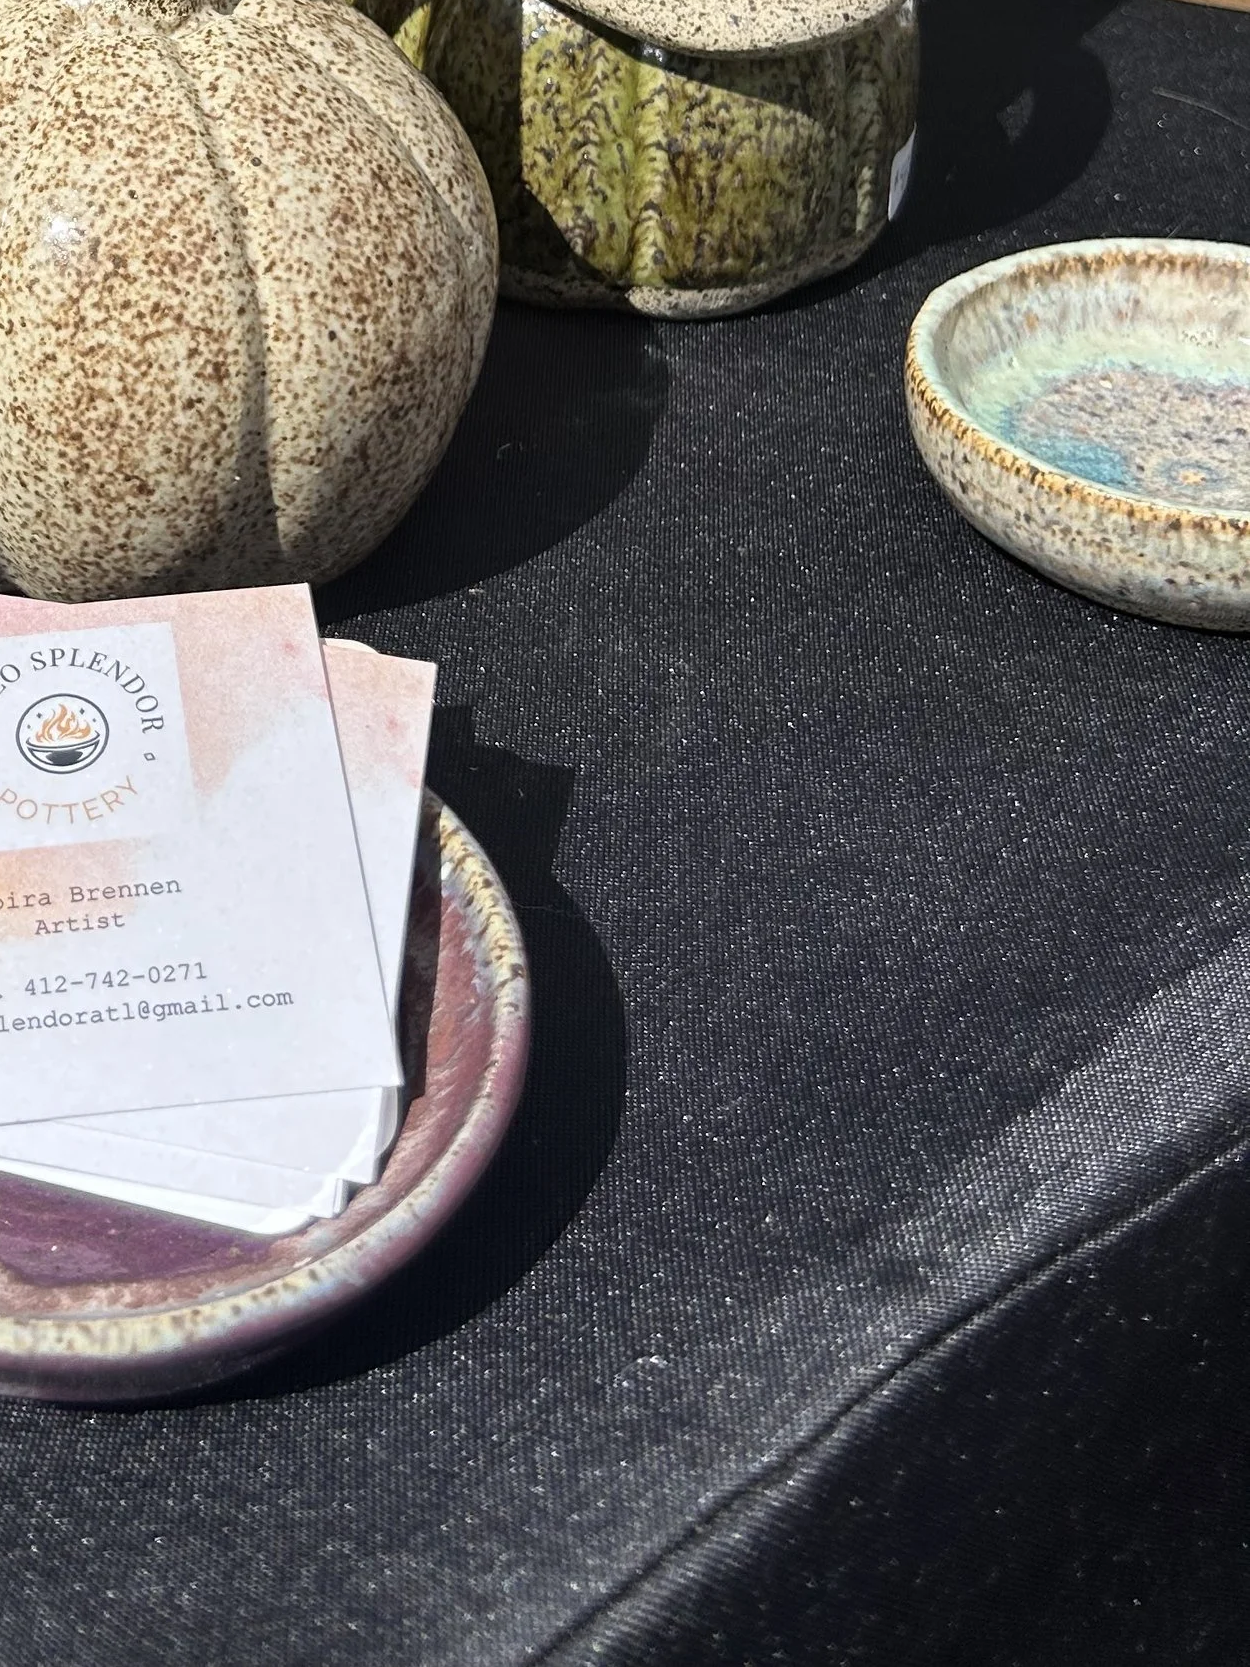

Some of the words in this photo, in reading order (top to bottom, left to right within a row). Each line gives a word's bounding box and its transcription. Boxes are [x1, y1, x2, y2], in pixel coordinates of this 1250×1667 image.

[29, 647, 165, 734] SPLENDOR
[69, 877, 183, 904] Brennen
[34, 911, 127, 935] Artist
[23, 961, 208, 998] 412-742-0271
